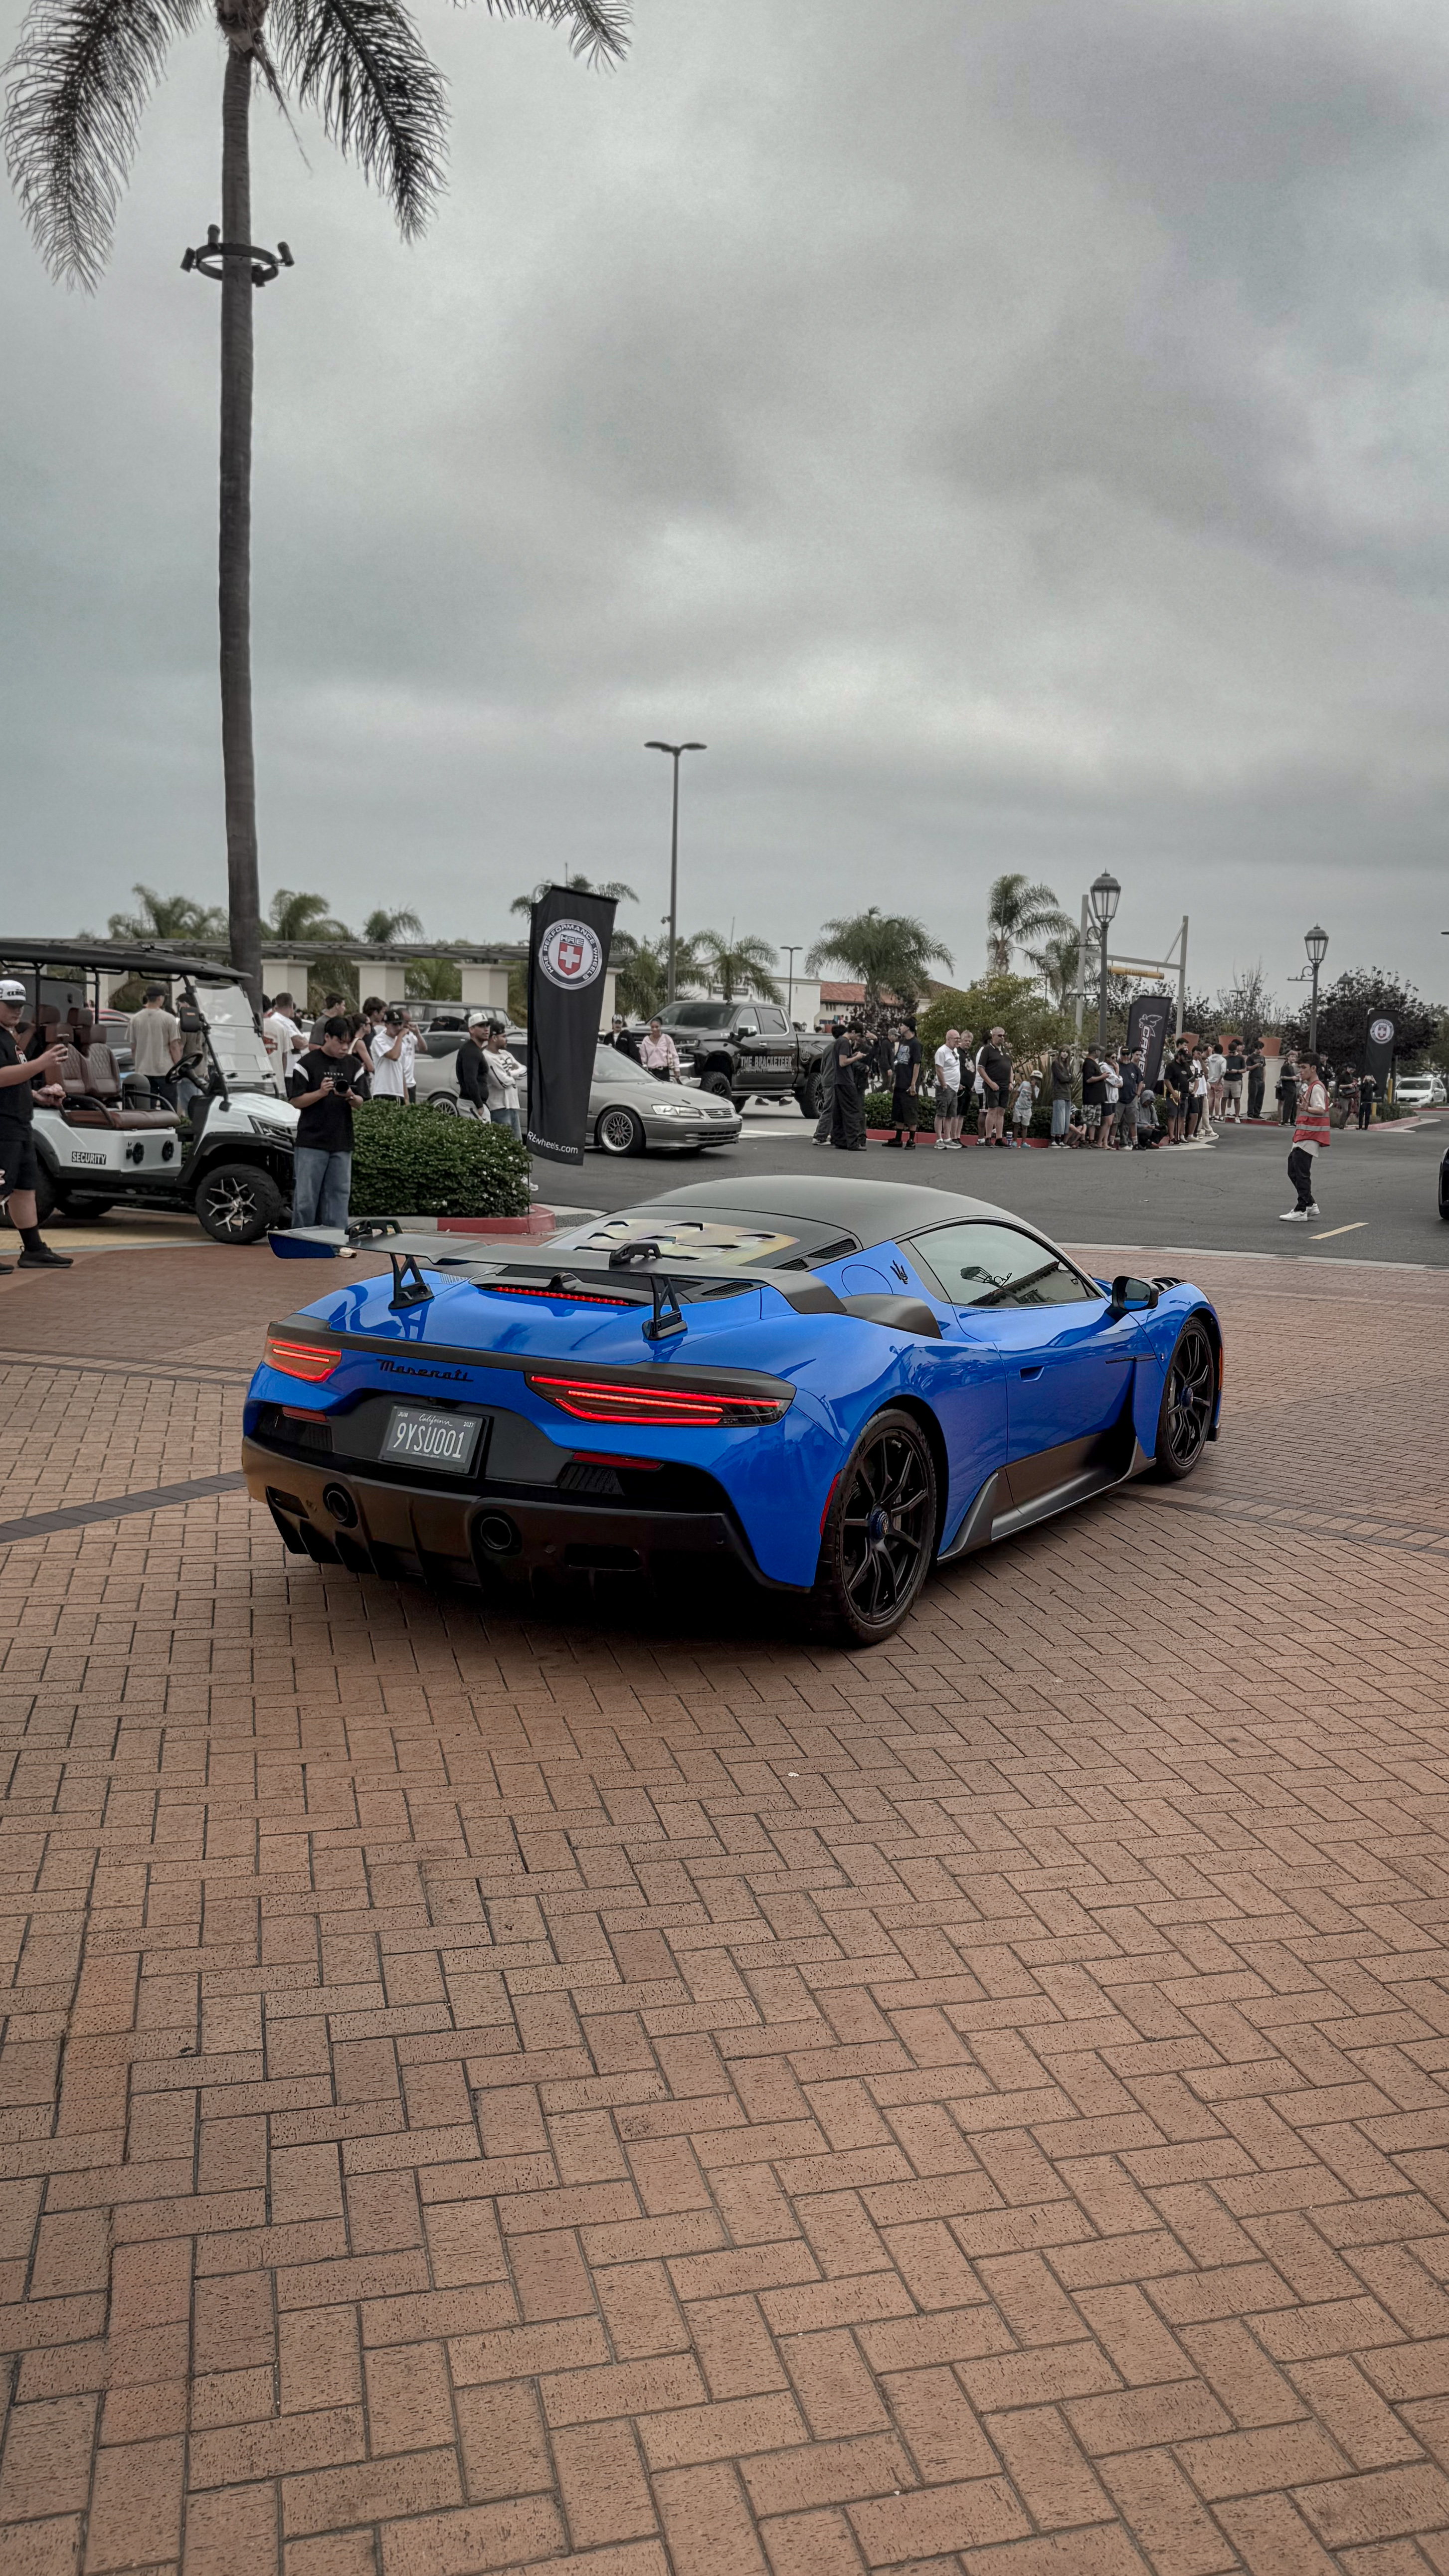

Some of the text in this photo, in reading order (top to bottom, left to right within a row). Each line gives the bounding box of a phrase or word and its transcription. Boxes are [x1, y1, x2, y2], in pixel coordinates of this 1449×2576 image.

[560, 934, 584, 946] HRE
[543, 924, 595, 951] PERFORMANCE
[582, 947, 598, 980] WHEELS
[740, 1056, 792, 1067] THE BRACKETEER
[72, 1152, 106, 1164] SECURITY
[375, 1359, 474, 1382] Maserati
[419, 1413, 453, 1426] California
[393, 1422, 464, 1458] 9YSU001
